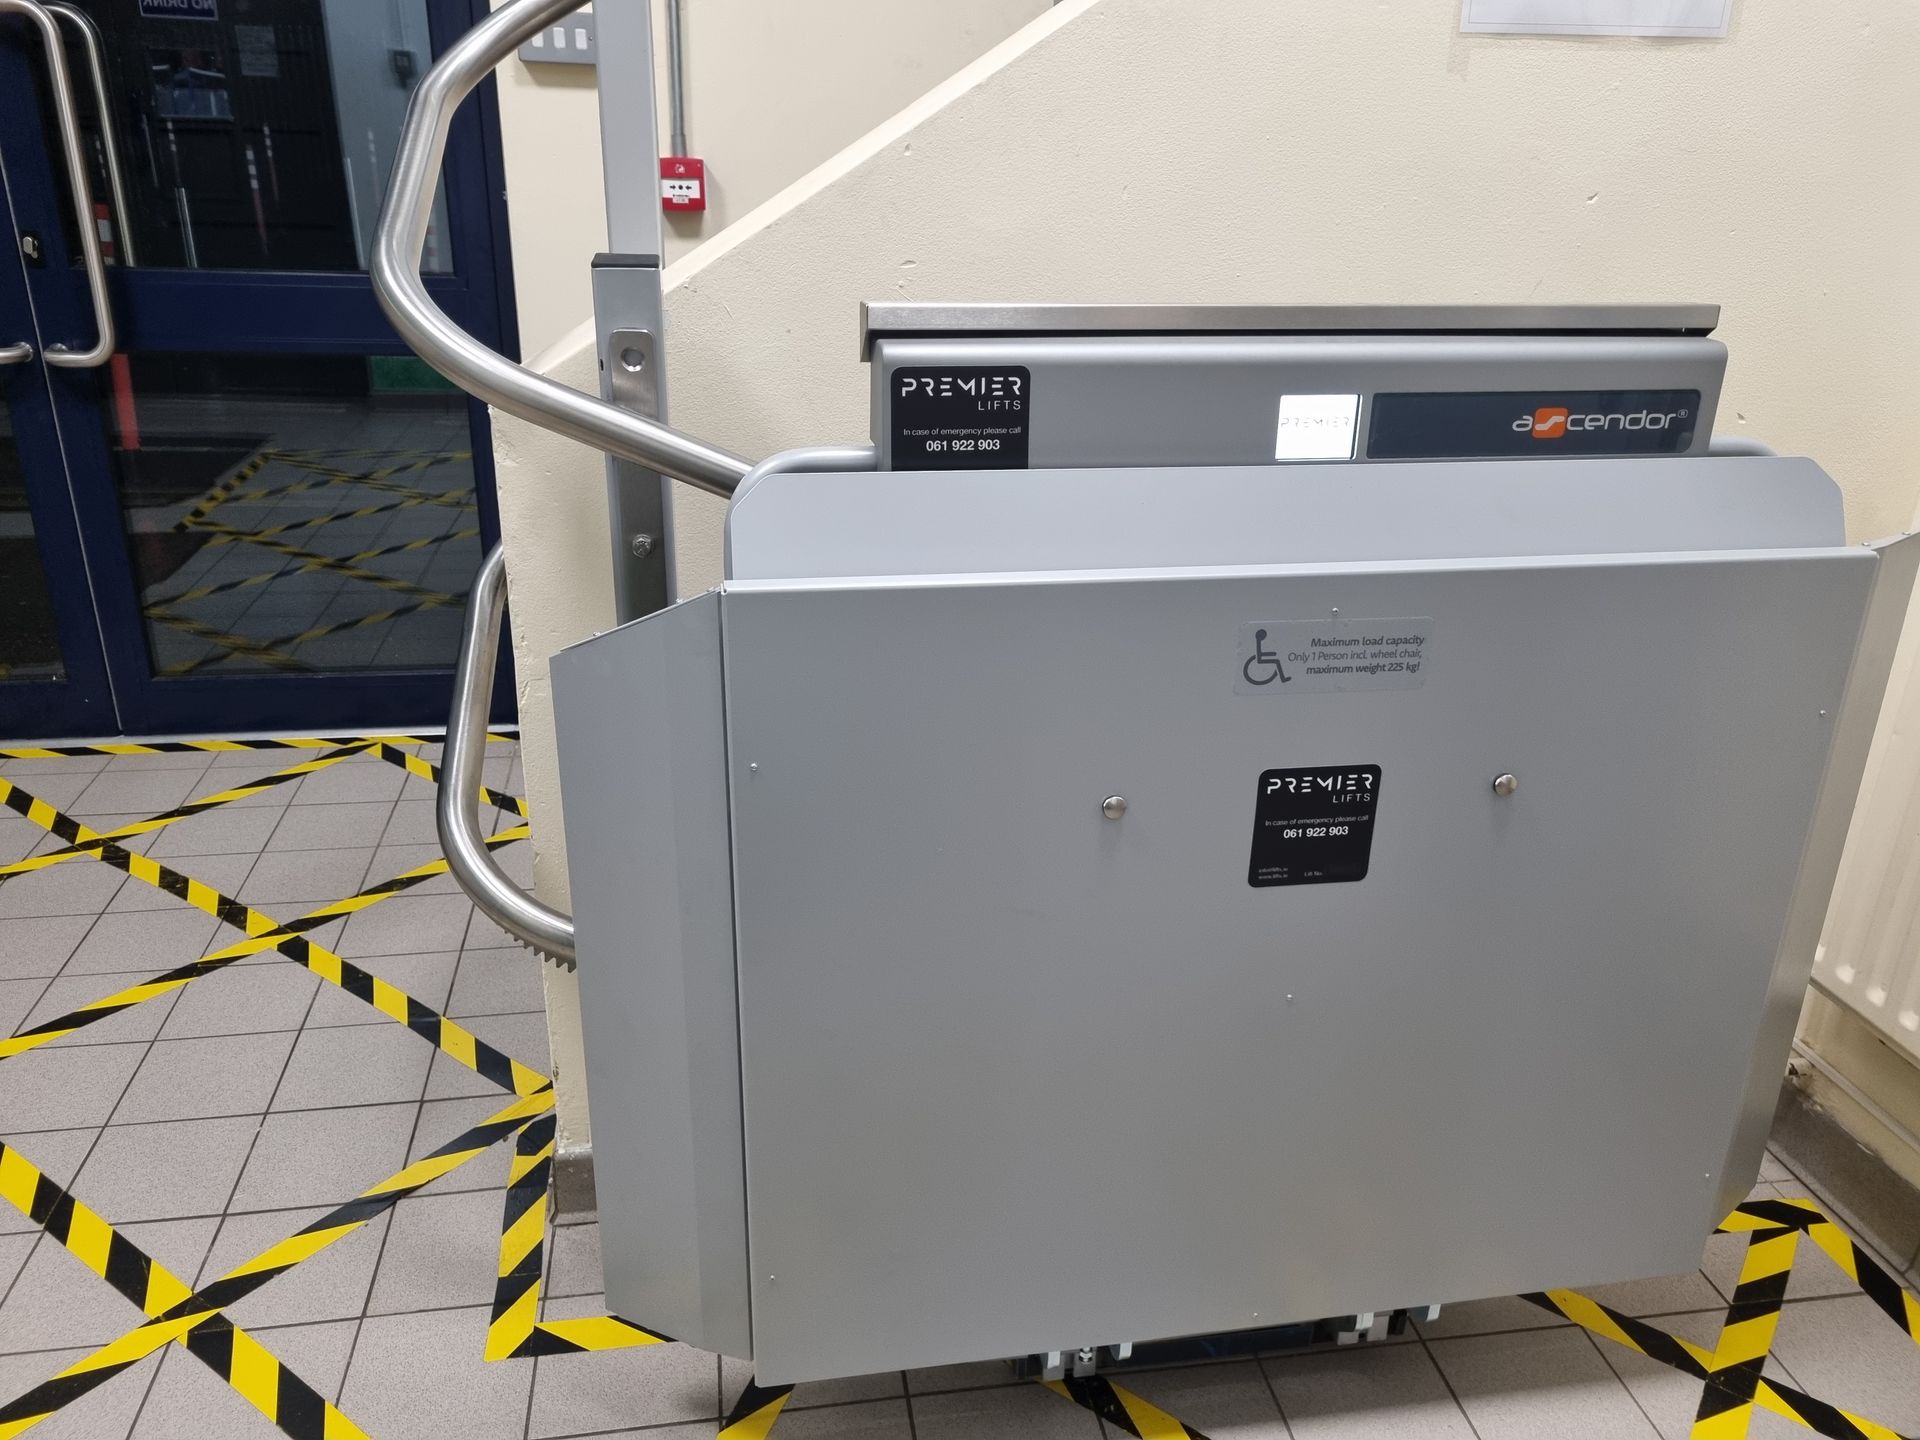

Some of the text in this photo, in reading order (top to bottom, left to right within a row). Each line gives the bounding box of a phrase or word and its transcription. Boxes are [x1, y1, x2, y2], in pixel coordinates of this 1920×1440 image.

[902, 377, 1021, 396] PREMIER
[978, 400, 1021, 411] LIFTS
[1280, 416, 1351, 429] PREMIER
[903, 426, 1022, 436] In case of emergency please call
[926, 439, 1001, 452] 061 922 903
[1311, 635, 1425, 648] Maximum load capacity
[1288, 652, 1310, 662] Only
[1312, 652, 1317, 661] 1
[1318, 651, 1349, 661] Person
[1370, 650, 1398, 659] wheel
[1399, 648, 1423, 660] chair,
[1306, 662, 1421, 675] maximum weight 225 kg!
[1267, 774, 1373, 794] PREMIER
[1332, 793, 1370, 803] LIFTS
[1265, 814, 1369, 827] In case of emergency please call
[1283, 826, 1348, 839] 061 922 903
